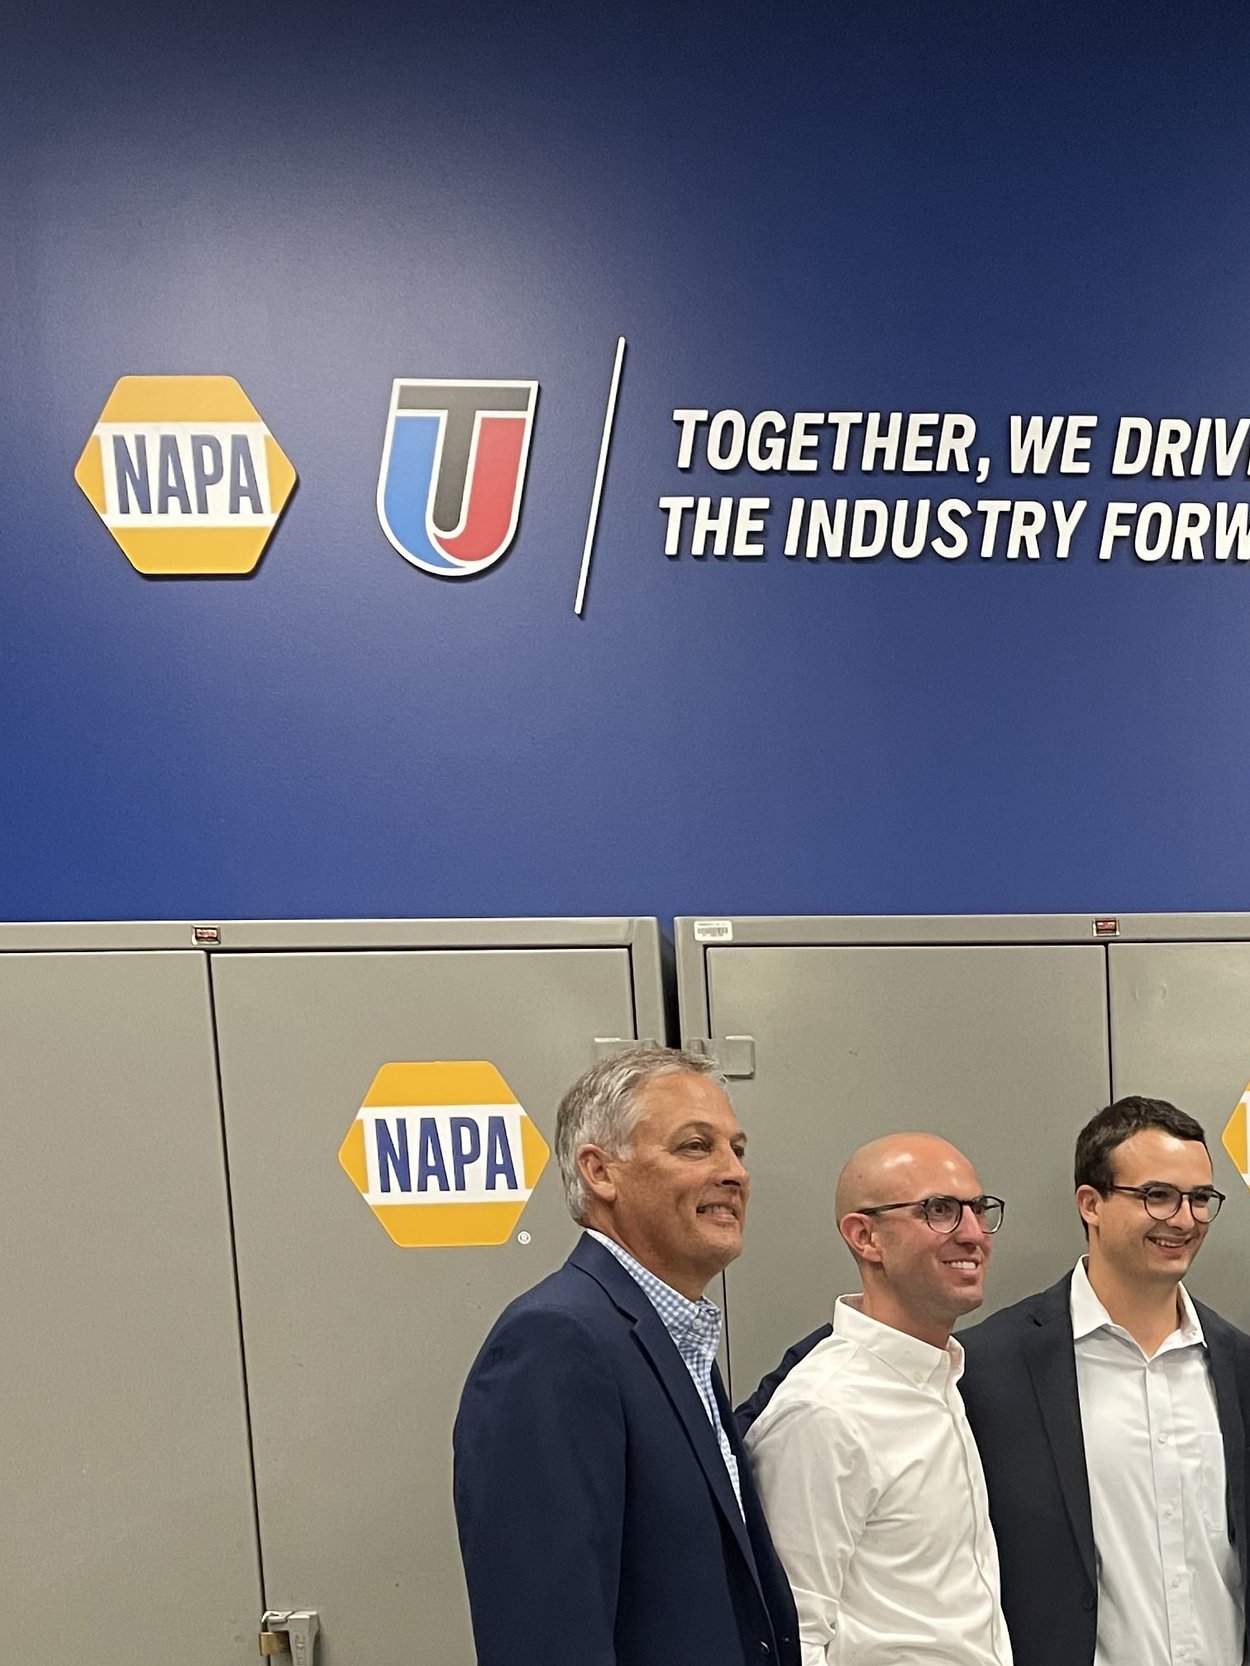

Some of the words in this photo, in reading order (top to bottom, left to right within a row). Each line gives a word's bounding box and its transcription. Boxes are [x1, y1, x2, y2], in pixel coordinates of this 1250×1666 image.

[113, 434, 265, 515] NAPA
[672, 408, 990, 484] TOGETHER,
[1010, 414, 1099, 475] WE
[659, 496, 770, 556] THE
[784, 497, 1088, 560] INDUSTRY
[374, 1115, 519, 1193] NAPA
